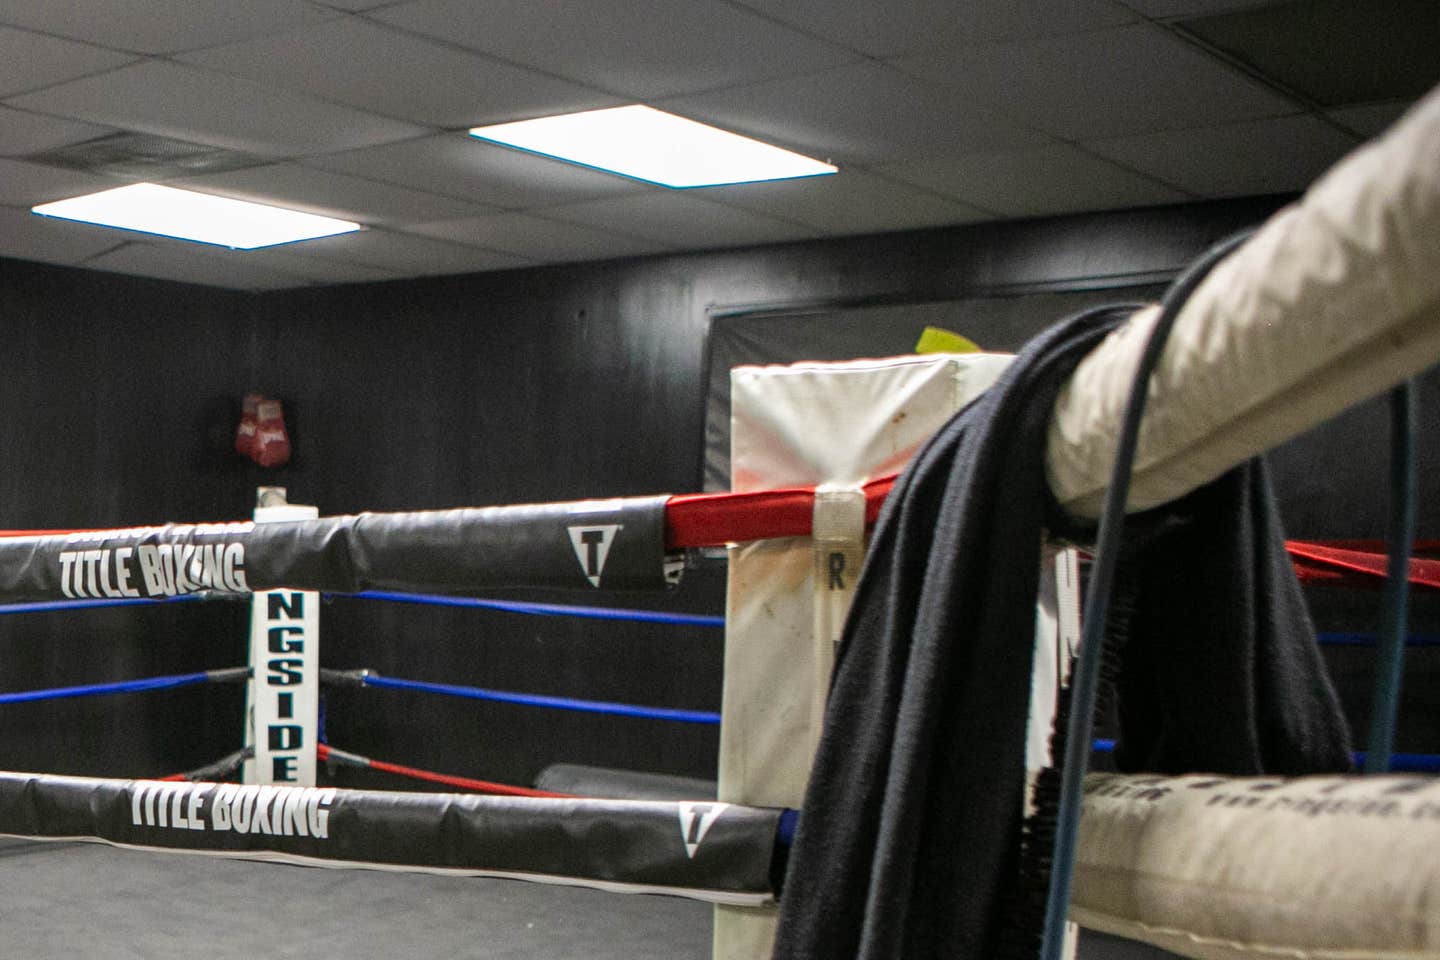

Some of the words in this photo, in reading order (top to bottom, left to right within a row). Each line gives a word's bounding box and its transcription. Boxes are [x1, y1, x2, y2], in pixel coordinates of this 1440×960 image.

[60, 547, 140, 599] TITLE
[138, 543, 253, 597] BOXING
[266, 592, 304, 783] NGSIDE
[132, 781, 216, 831] TITLE
[211, 783, 337, 839] BOXING
